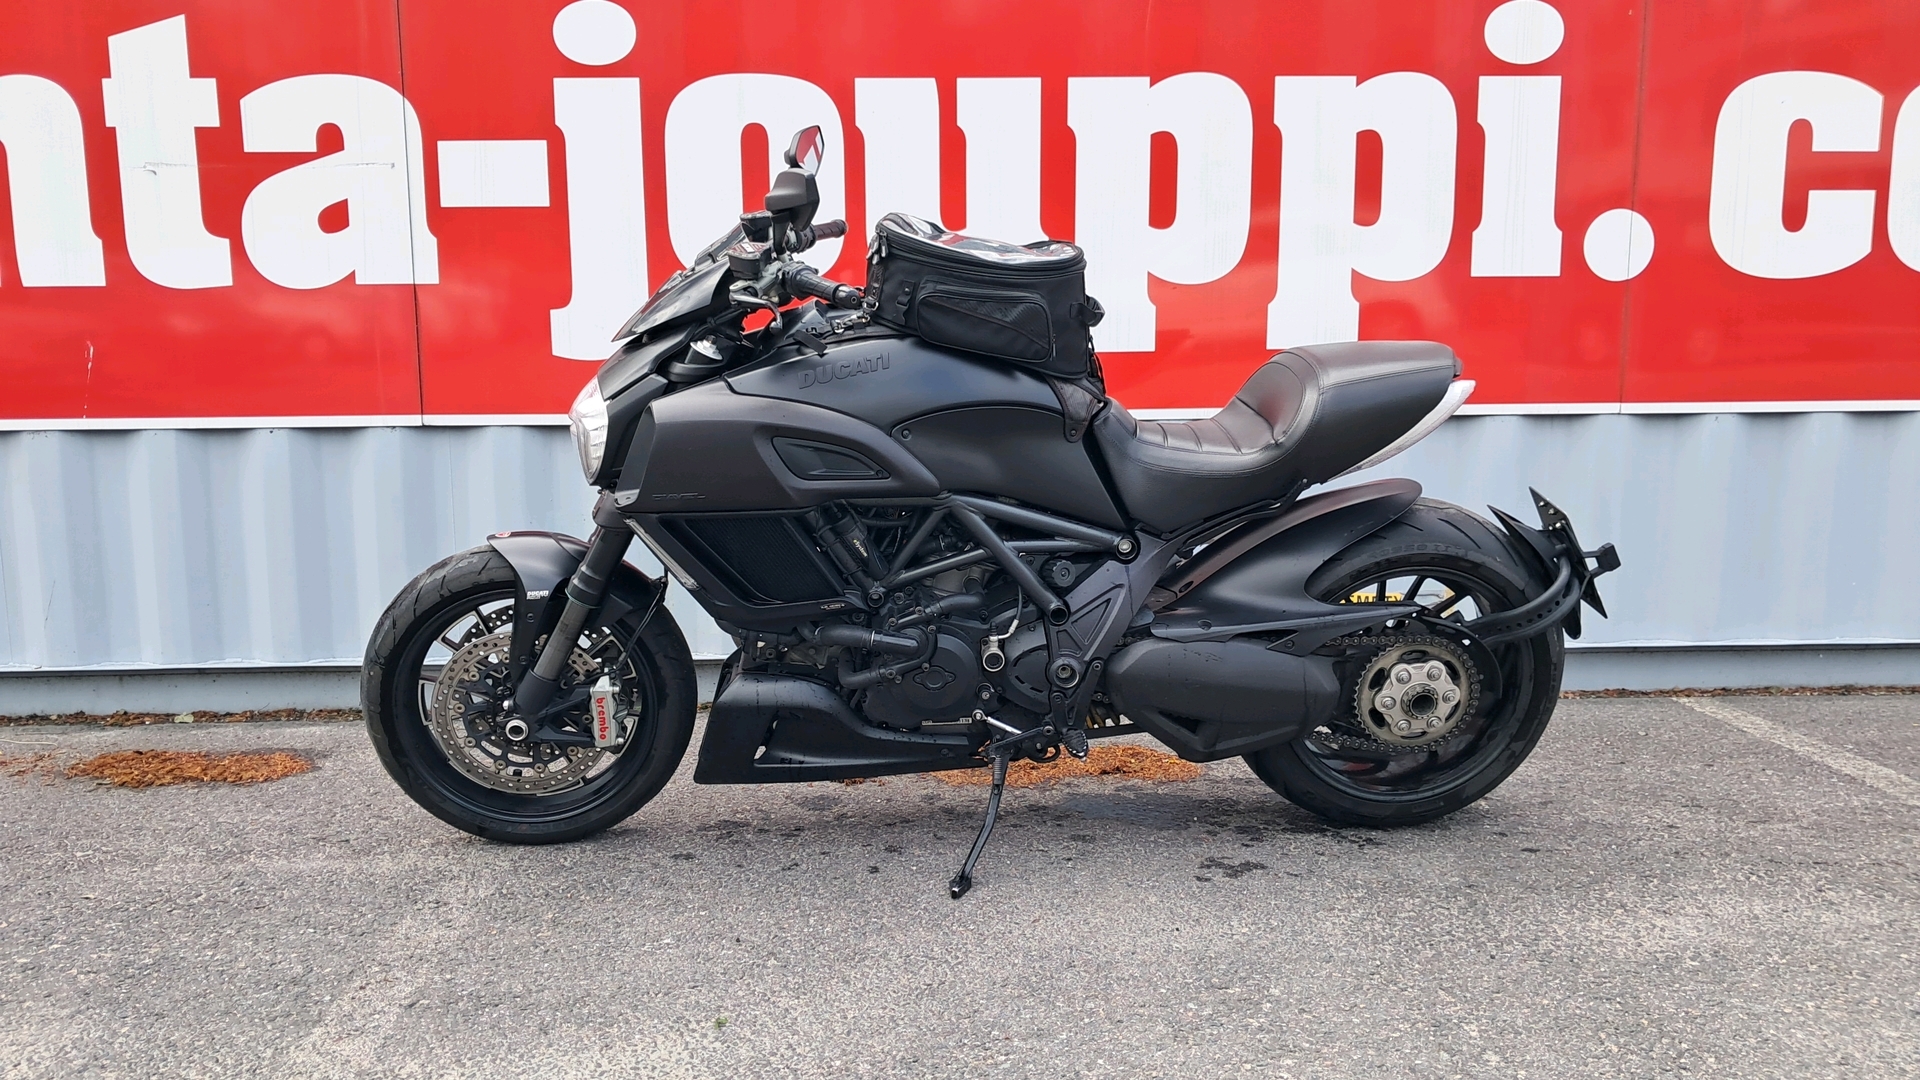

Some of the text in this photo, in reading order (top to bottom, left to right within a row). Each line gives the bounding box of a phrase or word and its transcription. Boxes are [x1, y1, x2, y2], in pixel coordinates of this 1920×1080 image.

[0, 0, 1920, 361] nta-jouppi.c
[798, 352, 890, 389] DUCATI
[596, 697, 609, 740] brembo
